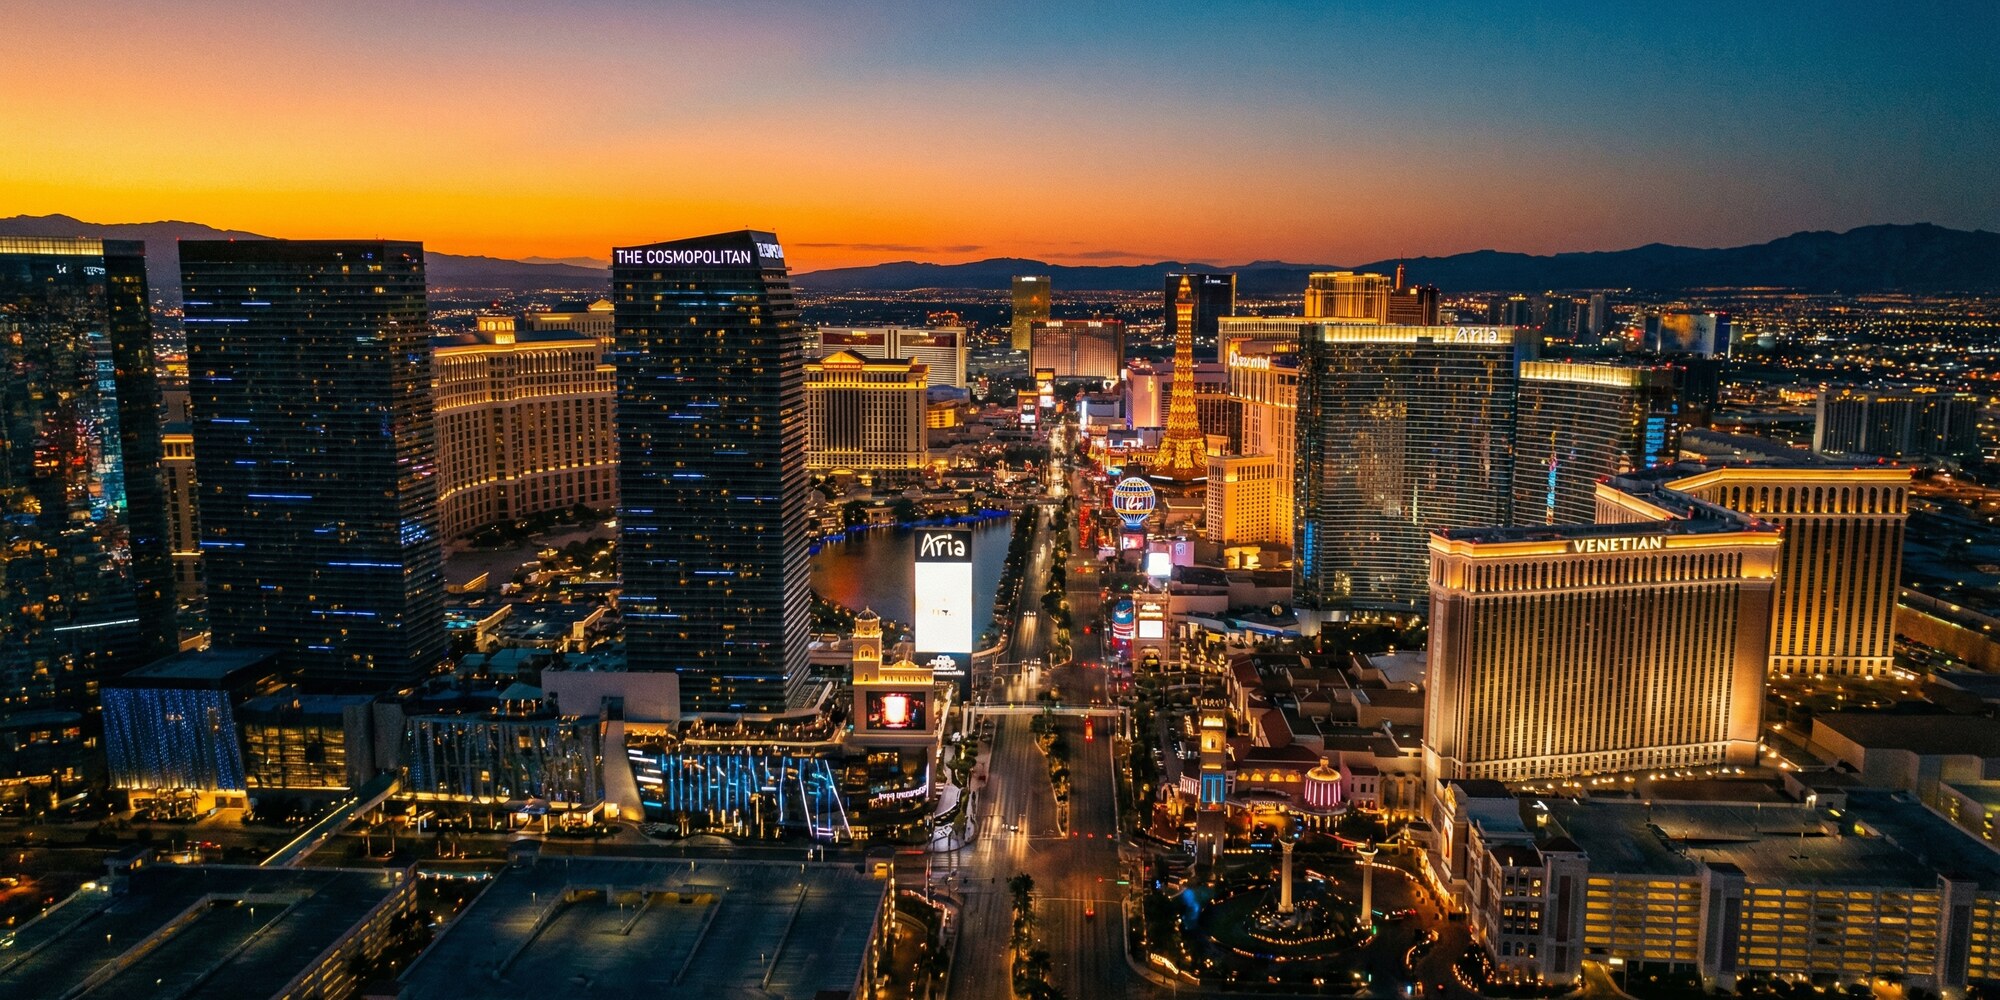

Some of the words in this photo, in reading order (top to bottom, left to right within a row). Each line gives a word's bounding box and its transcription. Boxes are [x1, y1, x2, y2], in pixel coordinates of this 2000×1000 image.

[616, 250, 643, 264] THE
[646, 250, 751, 264] COSMOPOLITAN
[920, 532, 966, 557] Aria
[1573, 536, 1662, 553] VENETIAN
